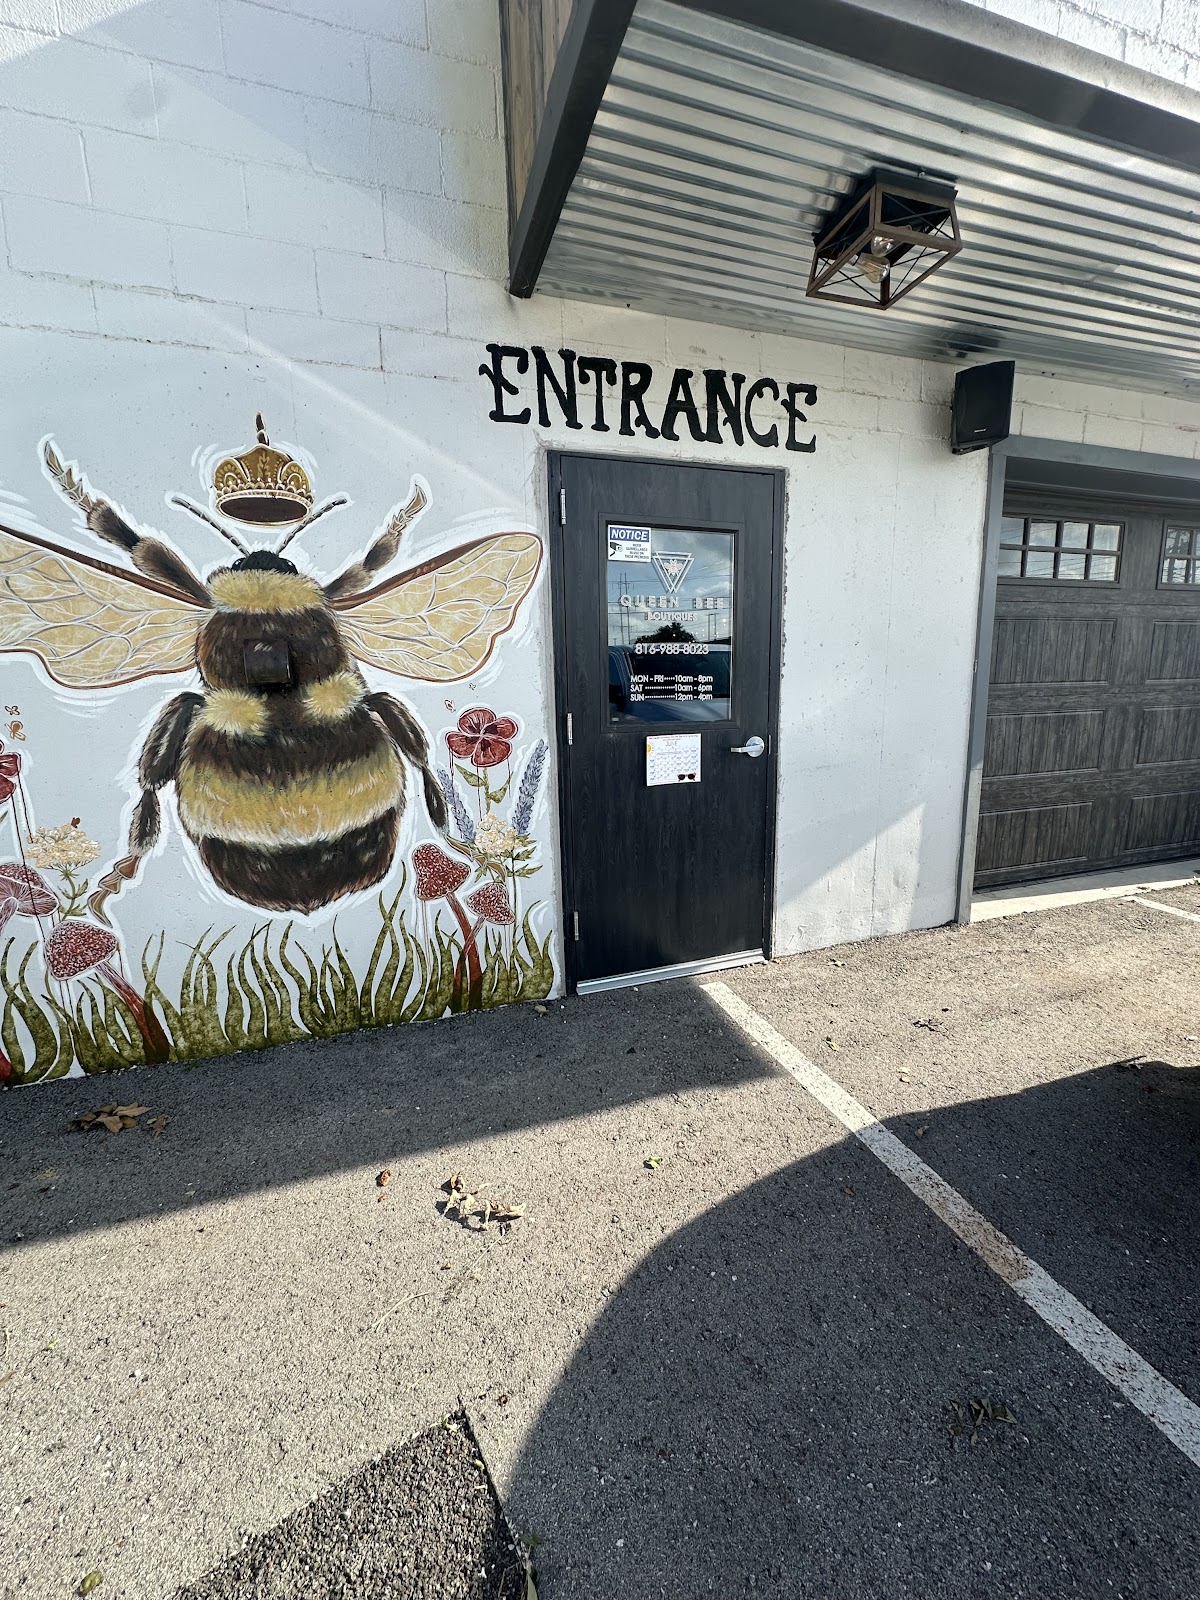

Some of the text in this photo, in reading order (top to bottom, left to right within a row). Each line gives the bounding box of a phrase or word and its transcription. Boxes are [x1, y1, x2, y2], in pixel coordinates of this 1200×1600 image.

[479, 343, 817, 453] ENTRANCE
[611, 529, 648, 541] NOTICE
[620, 595, 724, 609] QUEEN BEE
[647, 611, 698, 621] BOUTIQUES
[635, 644, 709, 655] 816-988-8023
[698, 675, 713, 683] 8pm
[698, 684, 712, 692] 6pm
[675, 693, 693, 701] 12pm
[698, 693, 712, 701] 4pm
